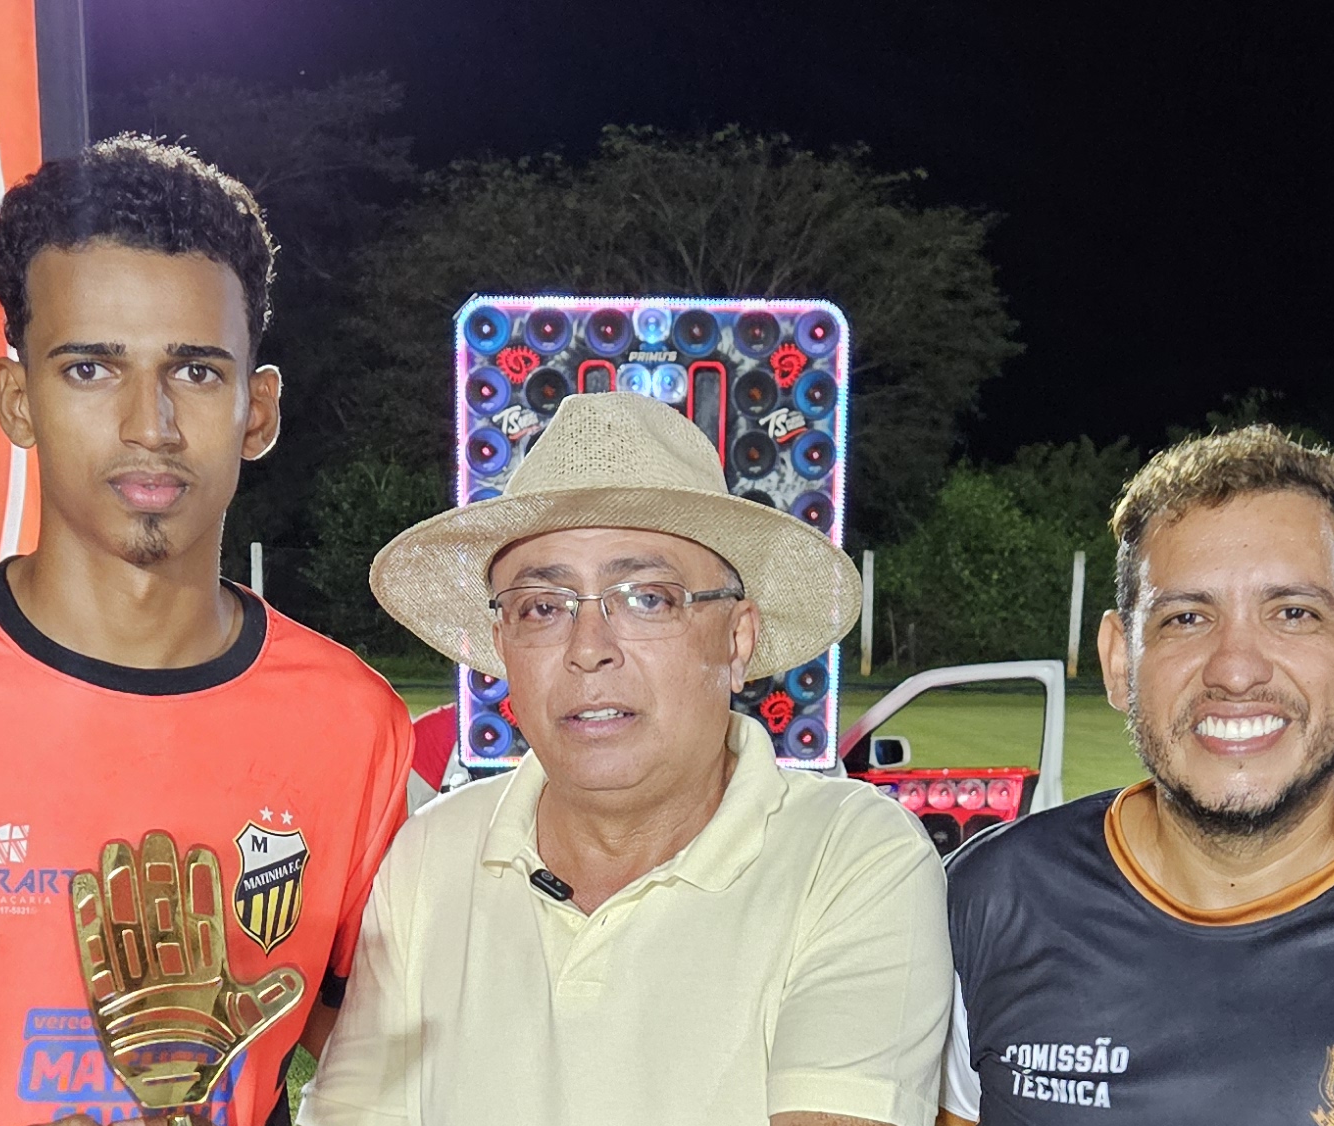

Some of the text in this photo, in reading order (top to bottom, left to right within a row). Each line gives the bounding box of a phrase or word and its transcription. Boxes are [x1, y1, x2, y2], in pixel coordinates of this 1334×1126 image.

[250, 834, 268, 853] M
[243, 864, 288, 892] MATINHA
[1000, 1036, 1130, 1074] COMISSÃO
[1012, 1068, 1112, 1109] TÉCNICA
